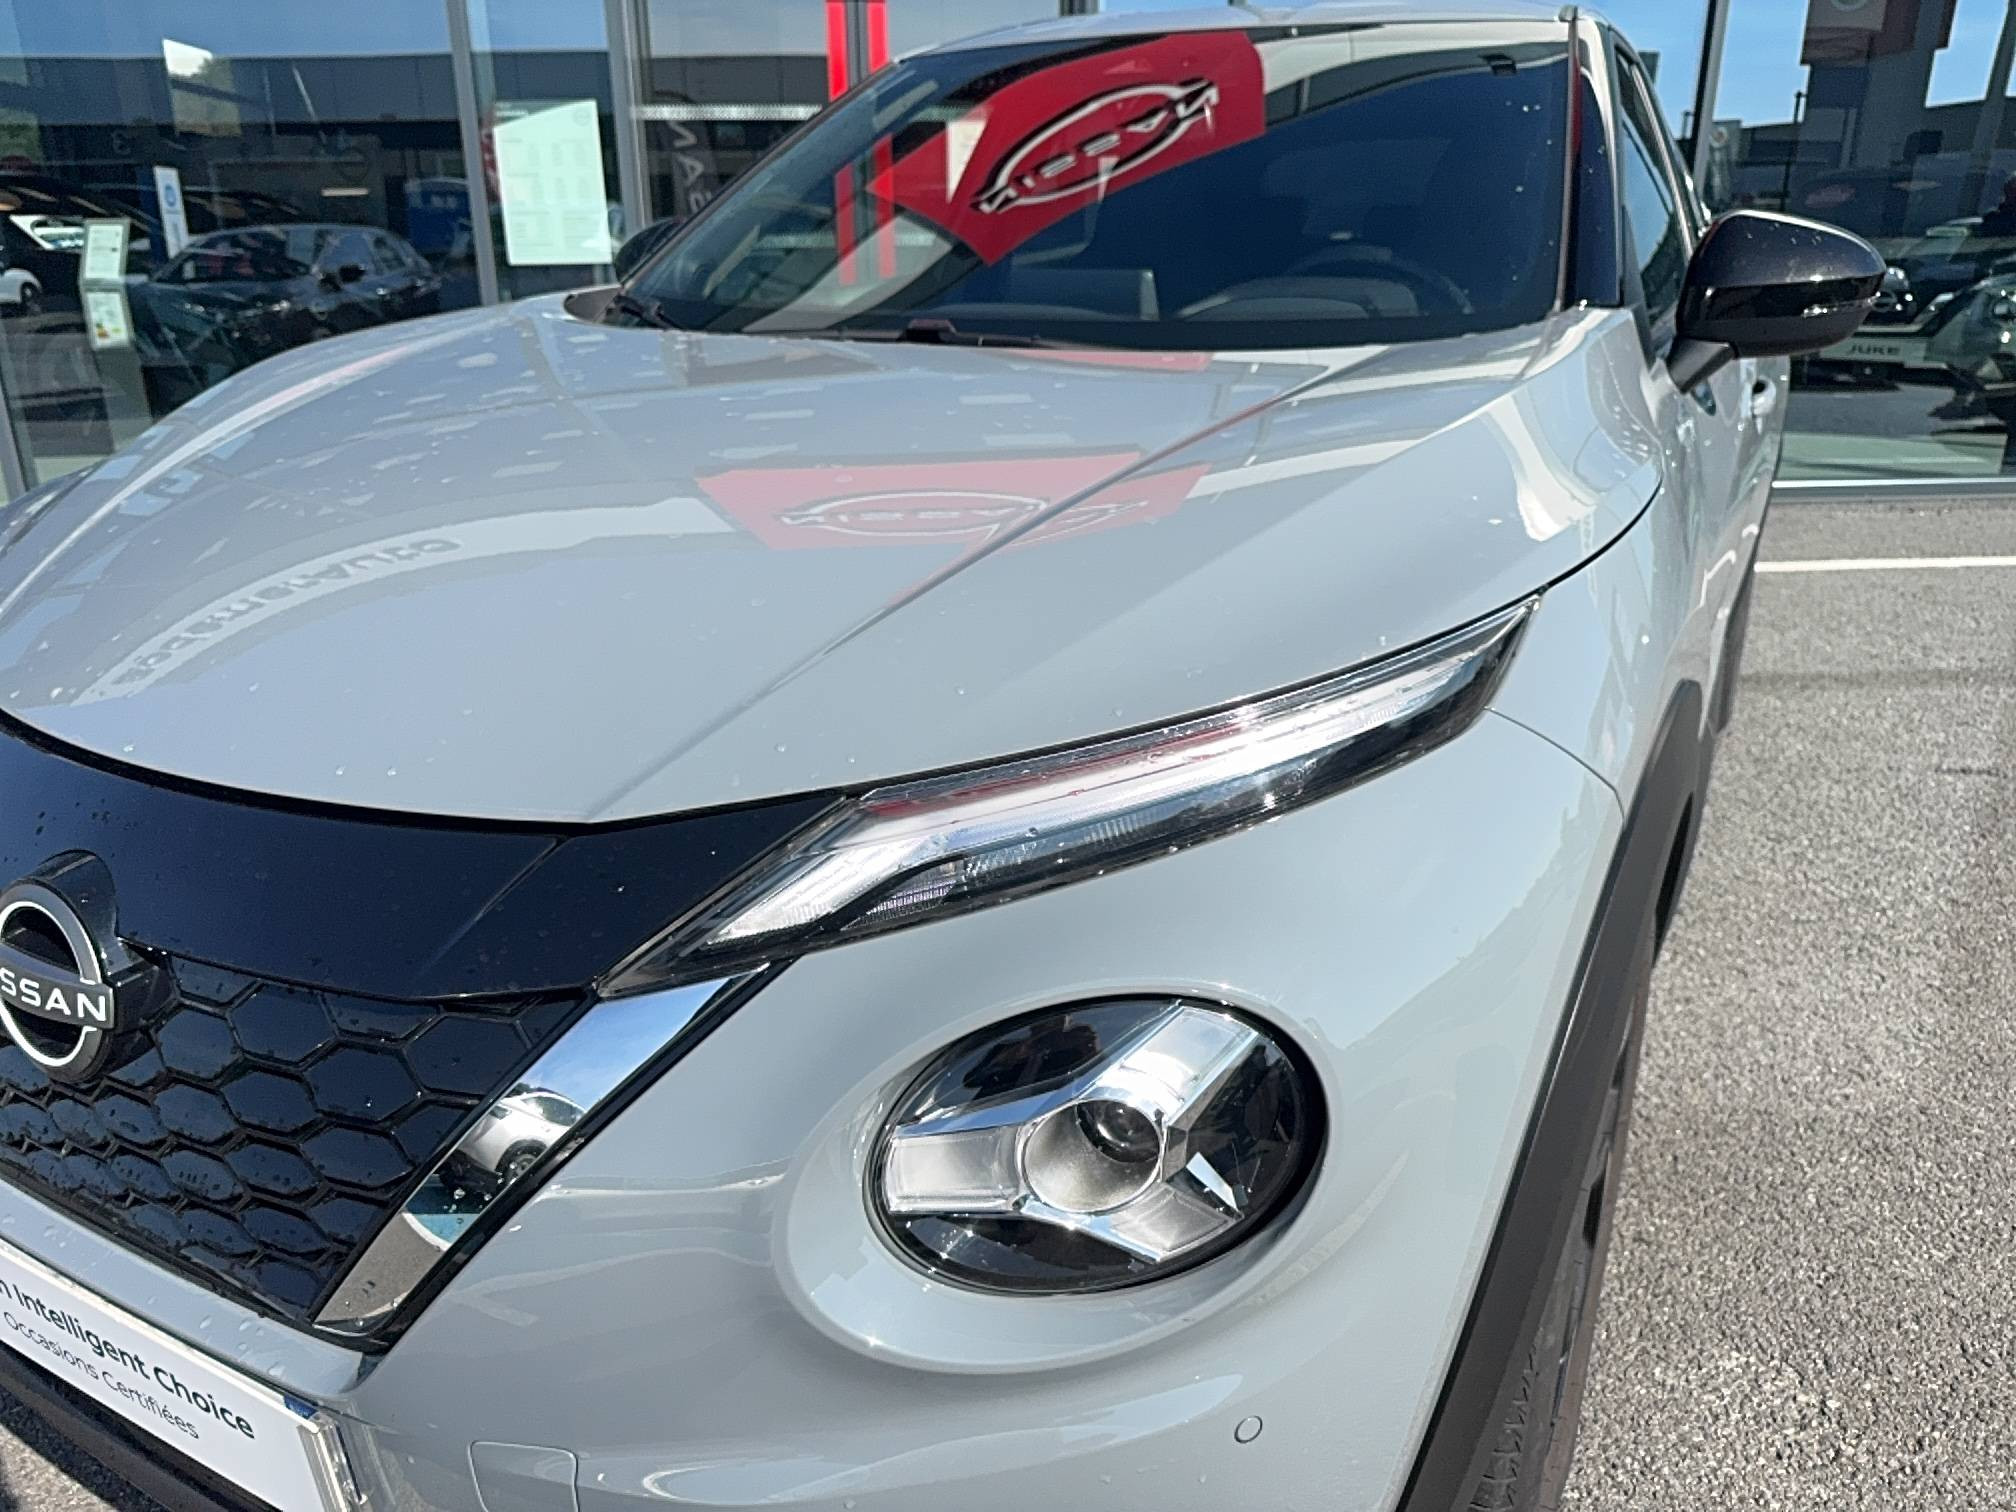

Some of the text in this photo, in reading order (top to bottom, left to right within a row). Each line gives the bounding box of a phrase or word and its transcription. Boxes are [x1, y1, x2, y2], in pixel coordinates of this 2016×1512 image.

[3, 1311, 200, 1440] Occasions Certifiées
[12, 1283, 151, 1380] Intelligent
[153, 1366, 255, 1439] Choice
